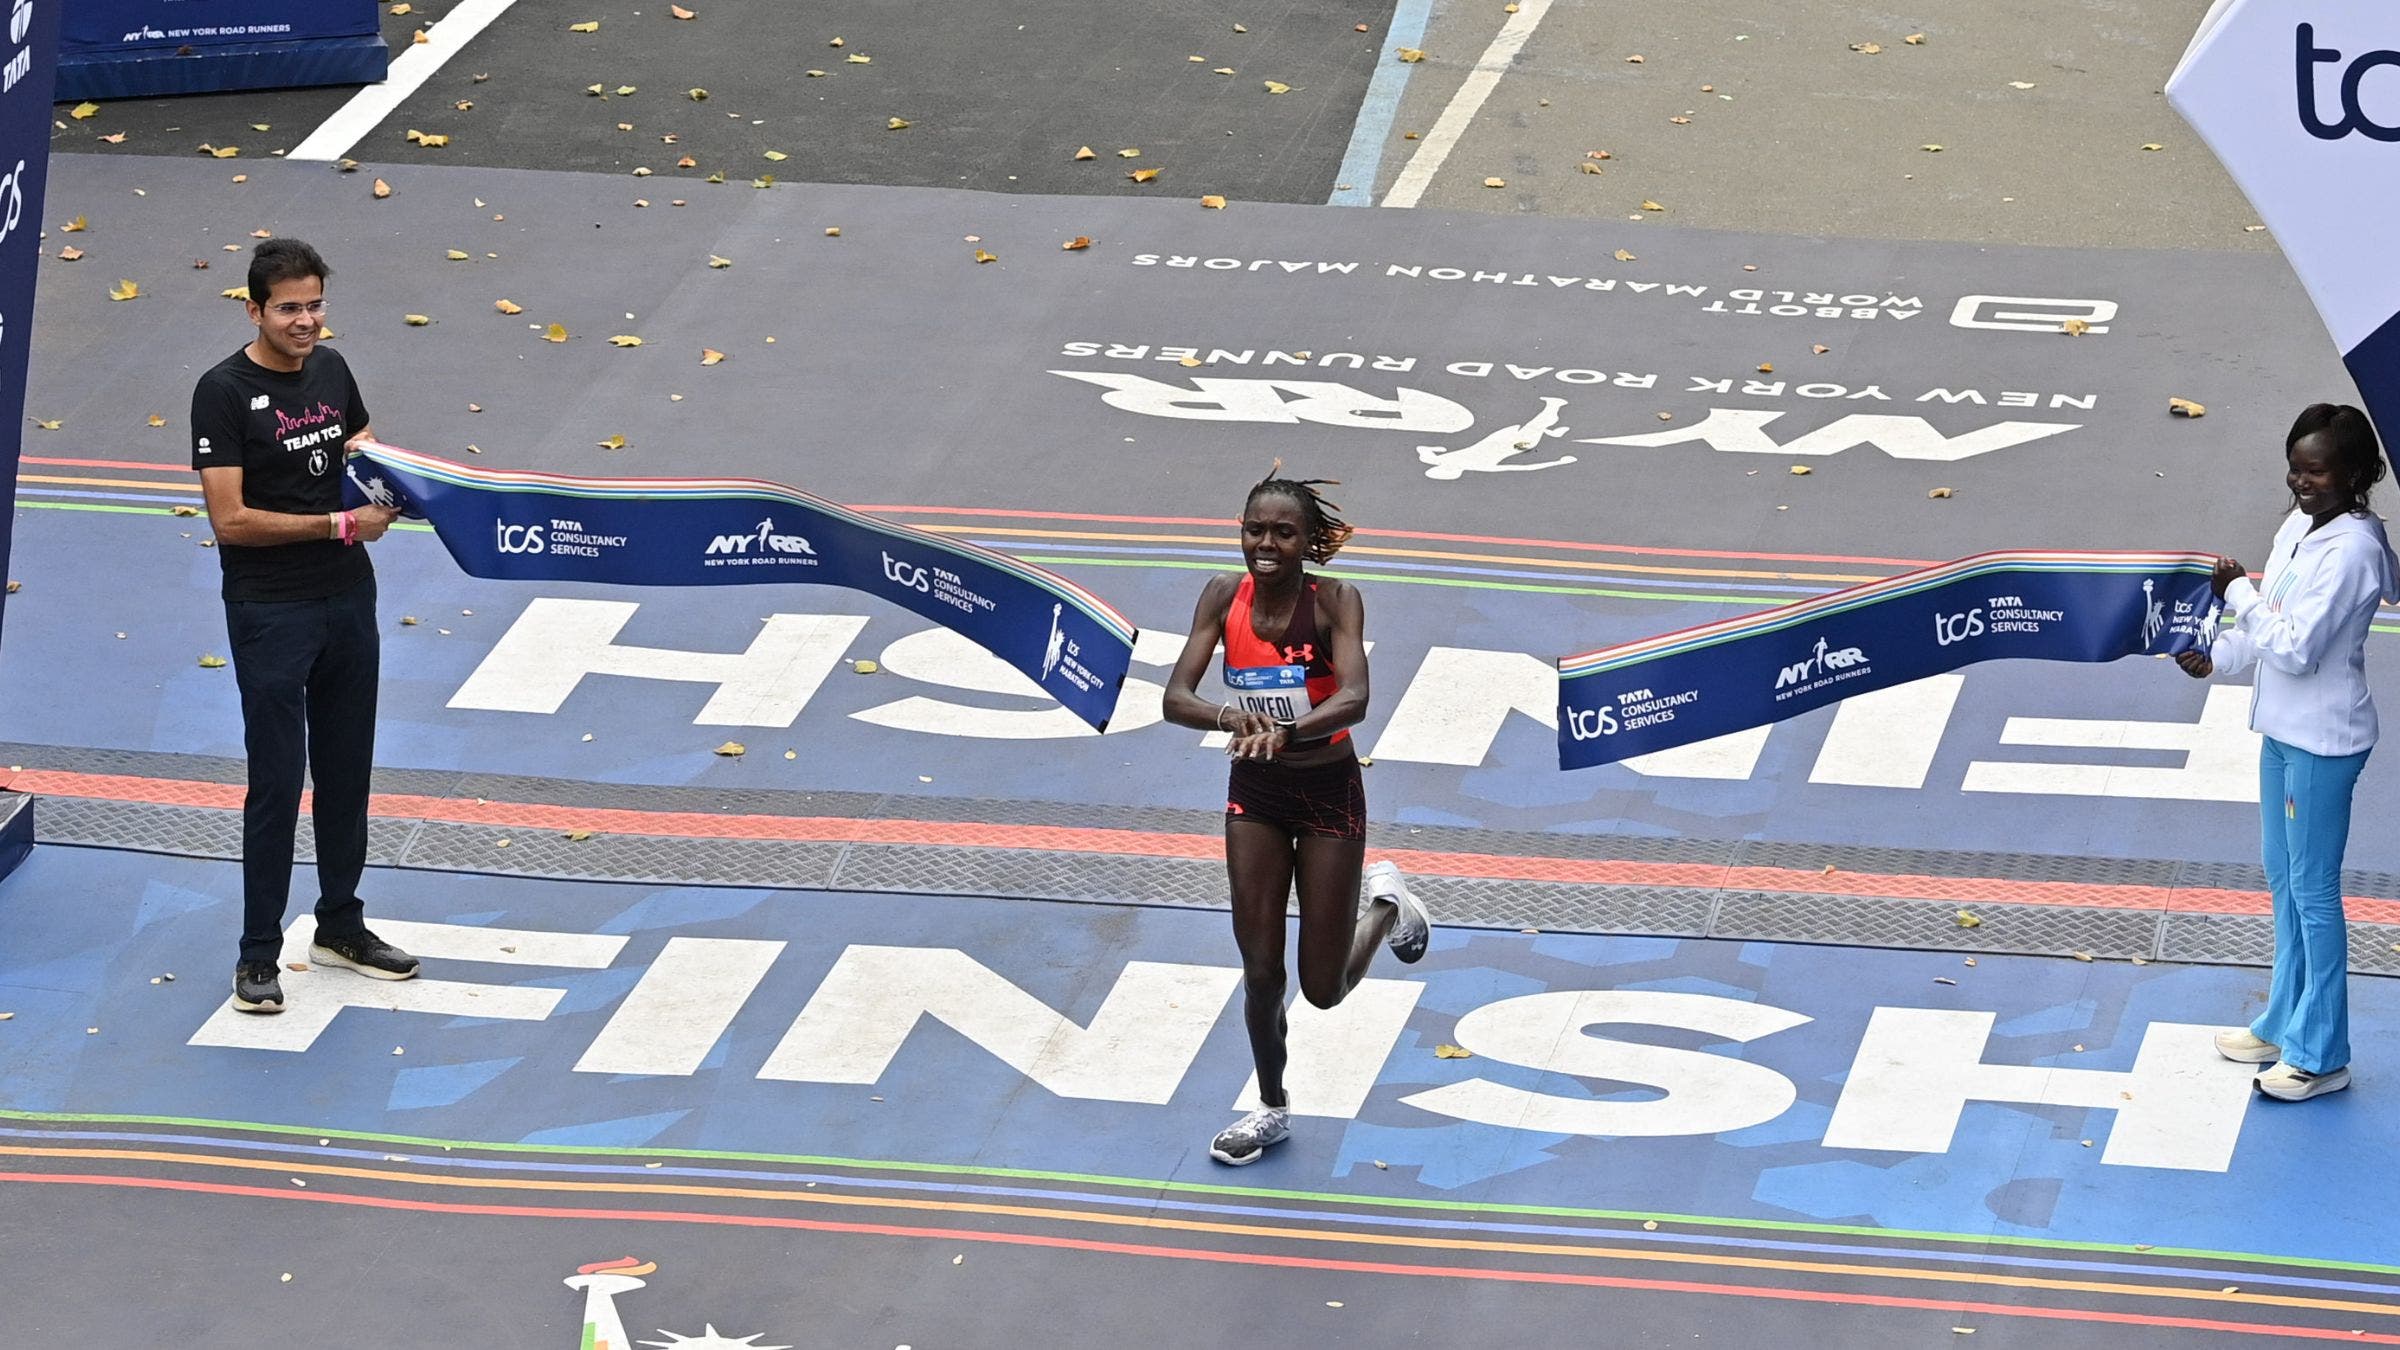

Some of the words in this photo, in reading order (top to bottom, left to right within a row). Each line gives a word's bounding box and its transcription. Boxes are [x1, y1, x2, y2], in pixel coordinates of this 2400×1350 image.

[167, 29, 190, 38] NEW
[192, 27, 218, 36] YORK
[219, 26, 246, 35] ROAD
[247, 24, 291, 34] RUNNERS
[3, 44, 31, 93] TATA
[2295, 22, 2400, 143] tc
[1131, 253, 1359, 274] MAJORS
[1385, 264, 1708, 298] MARATHON
[1728, 288, 1924, 308] WORLD
[1701, 300, 1922, 320] ABBOTT
[1060, 341, 1417, 372] RUNNERS
[1445, 361, 1658, 389] ROAD
[1685, 376, 1892, 400] YORK
[1915, 387, 2098, 410] NEW
[283, 431, 321, 452] TEAM
[320, 424, 343, 441] TCS
[496, 517, 545, 554] tcs
[550, 519, 583, 532] TATA
[550, 531, 627, 547] CONSULTANCY
[550, 543, 600, 557] SERVICES
[726, 558, 750, 566] YORK
[751, 557, 776, 565] ROAD
[778, 557, 819, 566] RUNNERS
[881, 550, 930, 593] tcs
[932, 566, 961, 585] TATA
[933, 578, 997, 612] CONSULTANCY
[933, 588, 973, 613] SERVICES
[1988, 596, 2023, 608] TATA
[2174, 600, 2193, 613] tcs
[1935, 608, 1985, 646] tcs
[1989, 609, 2064, 622] CONSULTANCY
[1990, 621, 2040, 633] SERVICES
[2172, 615, 2193, 624] NEW
[1090, 675, 1104, 690] CITY
[1775, 690, 1793, 702] NEW
[1794, 684, 1813, 695] YORK
[1813, 677, 1834, 689] ROAD
[1835, 666, 1872, 682] RUNNERS
[446, 597, 2260, 803] FINSH
[1617, 688, 1653, 705] TATA
[1621, 690, 1698, 718] CONSULTANCY
[1566, 705, 1618, 741] tcs
[1624, 709, 1675, 731] SERVICES
[187, 913, 2259, 1173] FINISH
